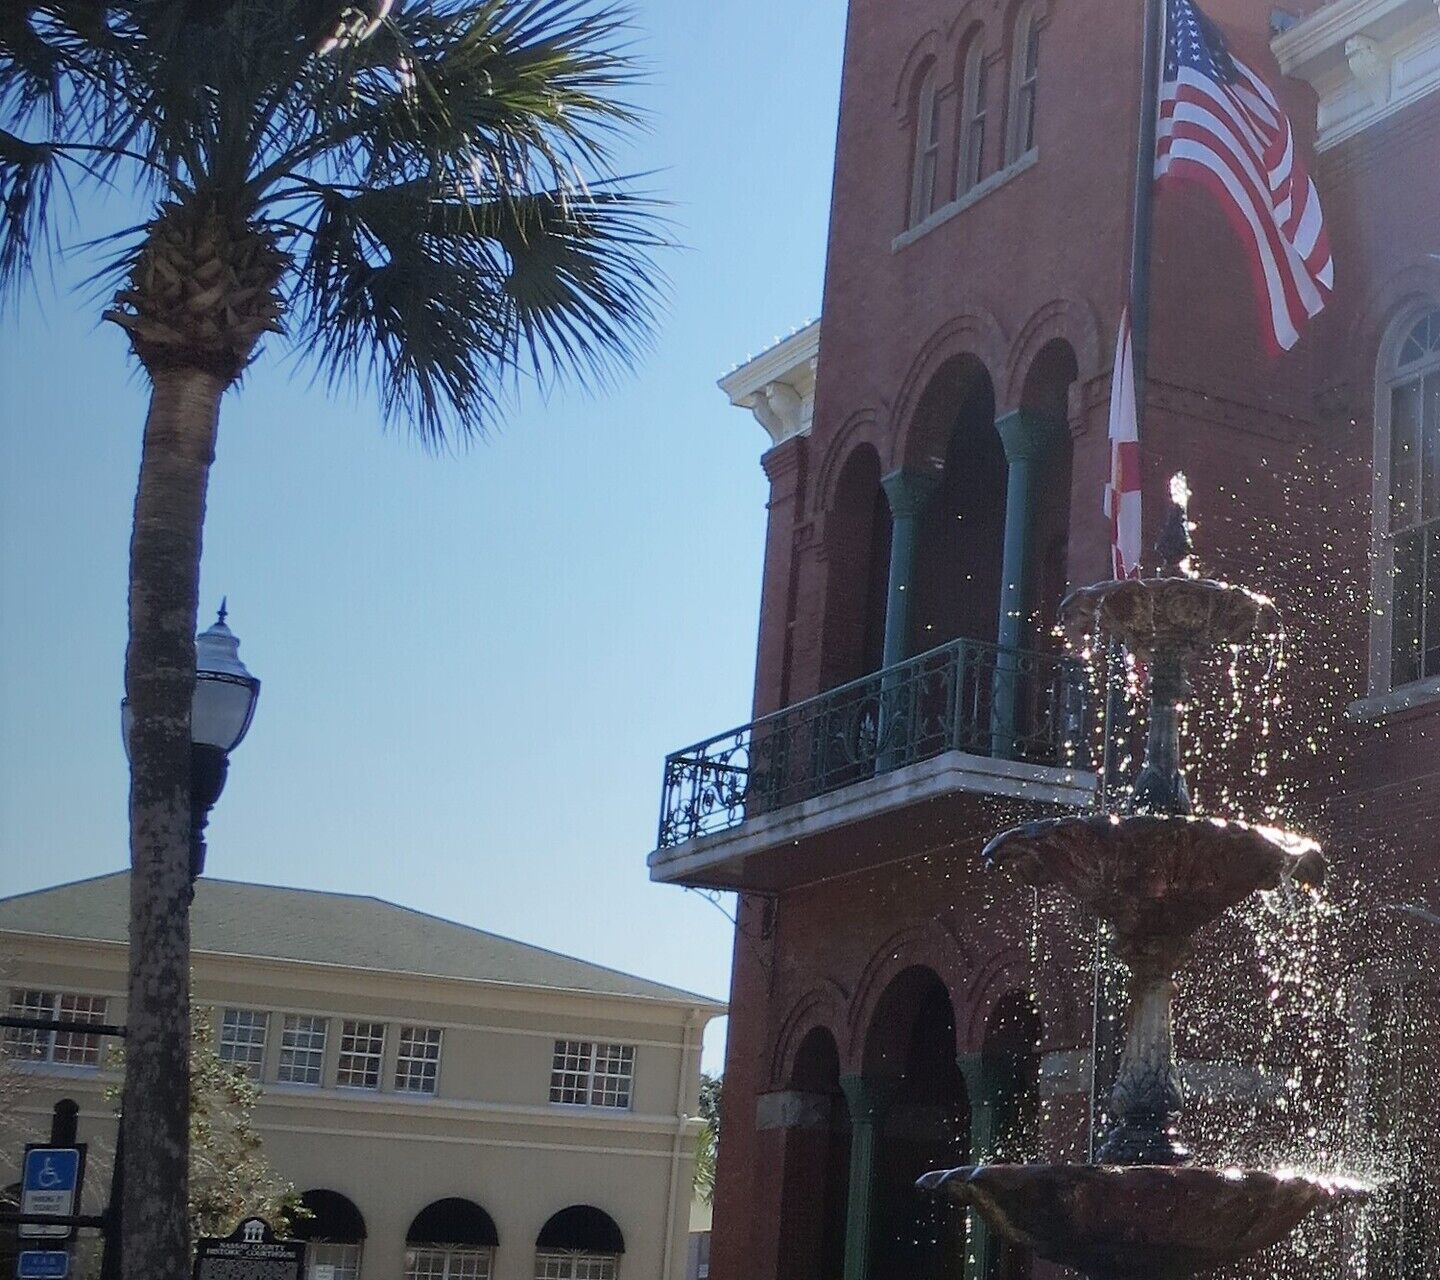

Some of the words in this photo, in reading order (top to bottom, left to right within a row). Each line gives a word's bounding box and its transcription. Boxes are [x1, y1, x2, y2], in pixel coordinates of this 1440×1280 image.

[206, 1247, 240, 1255] HISTORIC
[245, 1249, 297, 1258] COURTHOUSE
[251, 1243, 285, 1252] COUNTY
